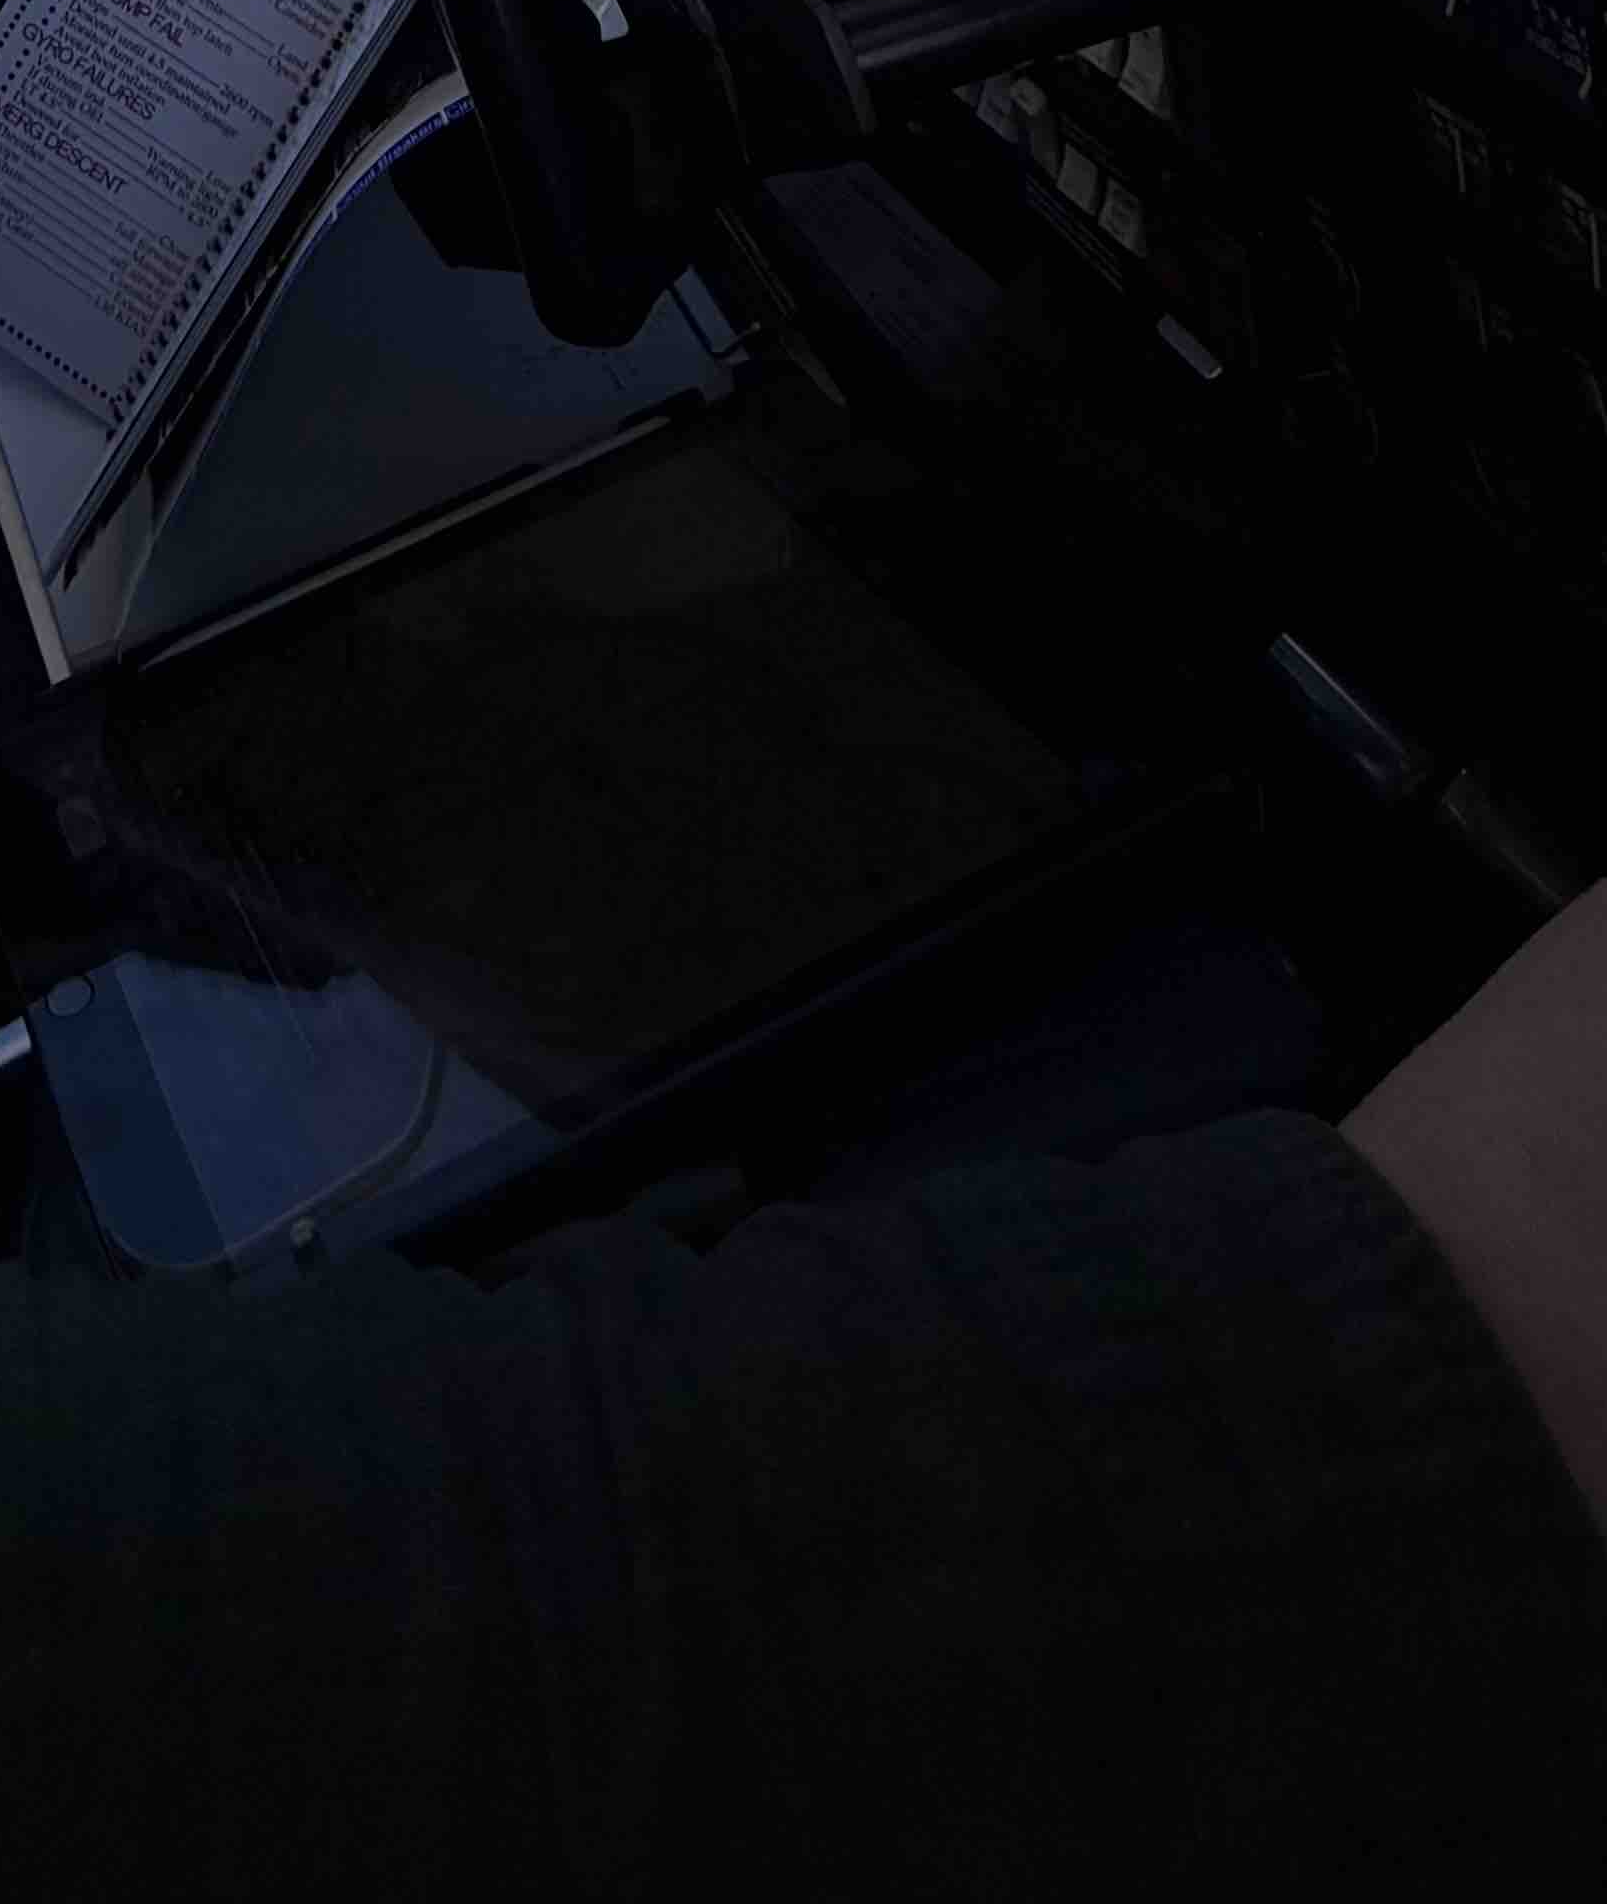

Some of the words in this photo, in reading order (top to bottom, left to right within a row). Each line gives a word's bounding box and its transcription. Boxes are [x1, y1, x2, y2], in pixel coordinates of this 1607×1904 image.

[147, 11, 185, 48] FAIL
[21, 22, 74, 65] GYRO
[72, 55, 156, 121] FAILURES
[276, 42, 309, 72] Land
[42, 130, 128, 194] DESCENT
